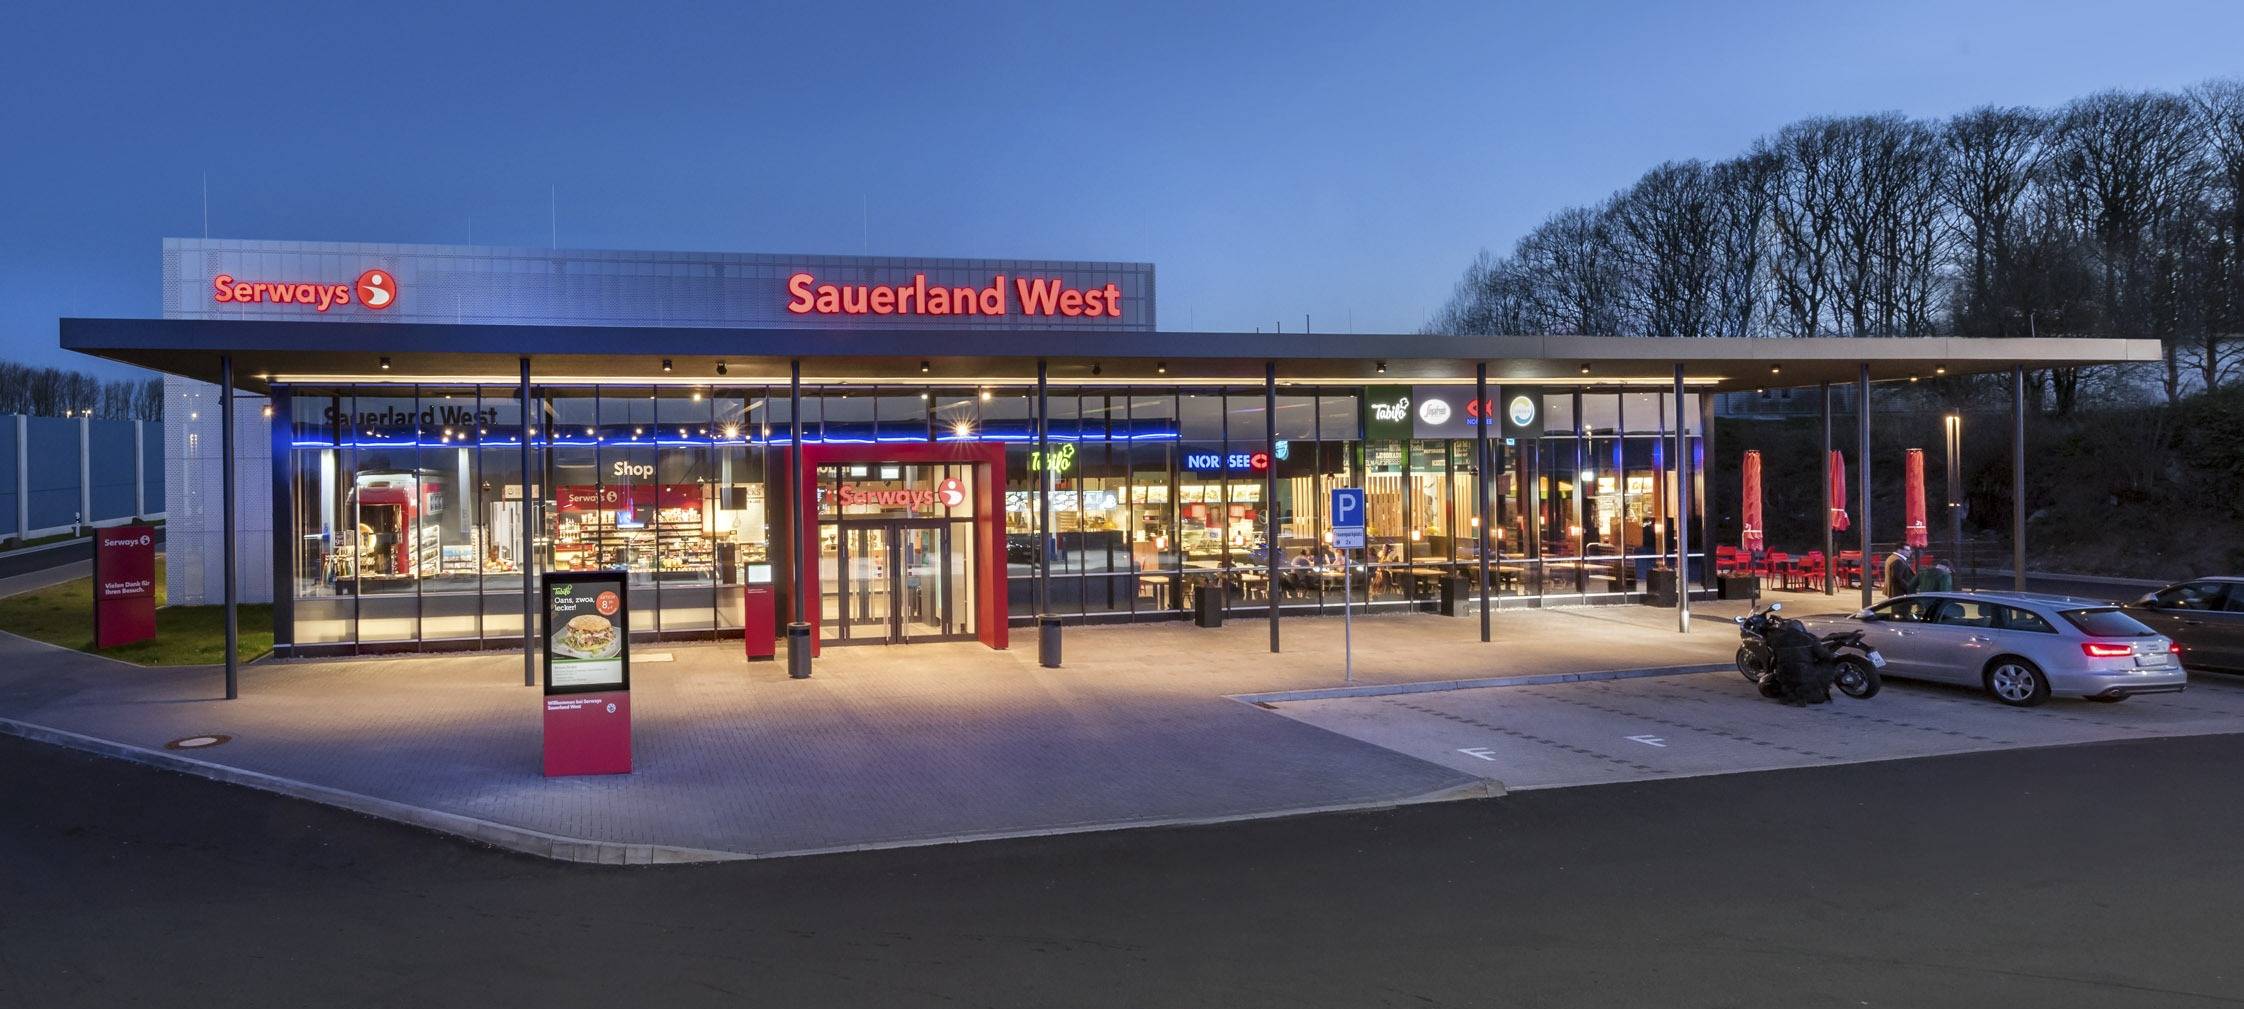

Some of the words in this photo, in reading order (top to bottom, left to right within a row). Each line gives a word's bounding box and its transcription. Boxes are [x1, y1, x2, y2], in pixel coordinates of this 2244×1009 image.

[214, 275, 349, 312] Serways
[788, 273, 1006, 315] Sauerland
[1016, 278, 1121, 317] West
[613, 461, 654, 479] Shop
[1188, 455, 1250, 468] NORSEE
[838, 485, 933, 512] Serways
[1339, 494, 1356, 521] P
[104, 538, 139, 547] Serways
[125, 580, 140, 588] Dank
[554, 604, 577, 612] lecker!
